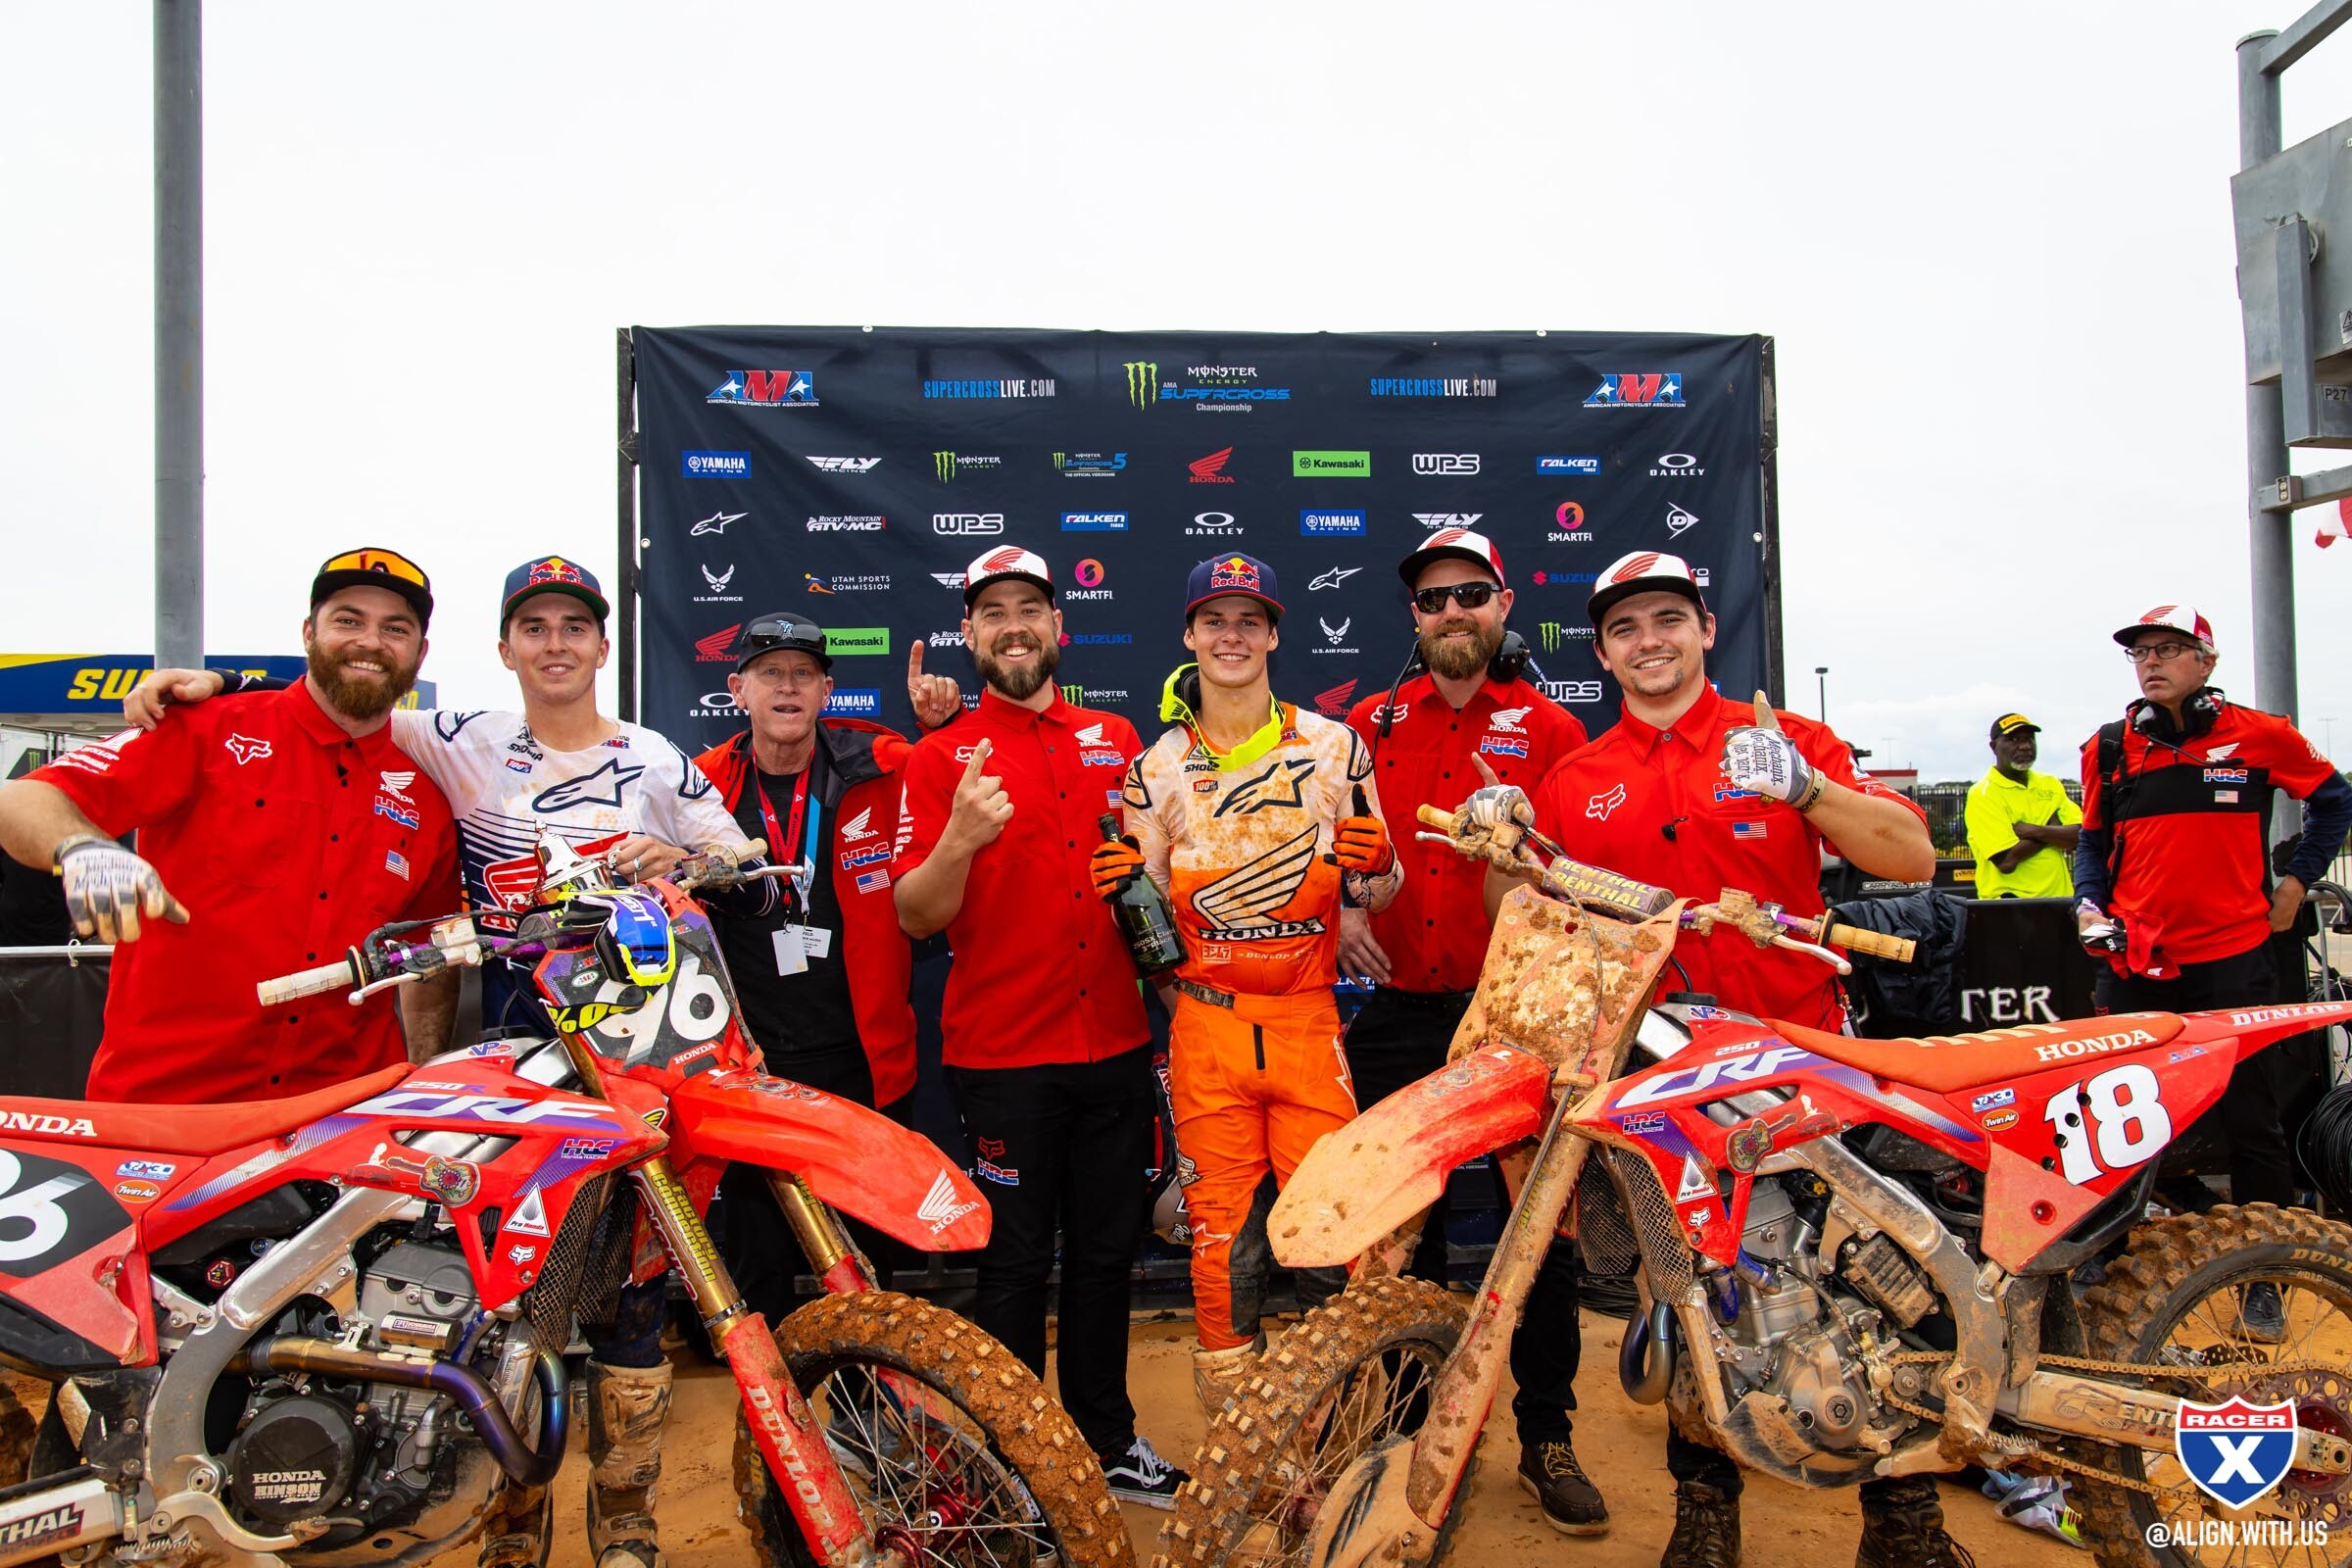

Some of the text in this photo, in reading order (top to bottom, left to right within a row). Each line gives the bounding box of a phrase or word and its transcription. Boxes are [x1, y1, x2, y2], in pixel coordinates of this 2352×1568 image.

[1188, 366, 1257, 377] MONSTER
[706, 369, 819, 401] AMA
[924, 379, 1055, 398] SUPERCROSSLIVE.COM
[1160, 389, 1291, 400] SUPERCROSS
[1370, 378, 1496, 397] SUPERCROSSLIVE.COM
[1582, 373, 1686, 403] AMA
[2325, 387, 2347, 401] P27
[1196, 403, 1251, 413] Championship
[702, 458, 745, 468] YAMAHA
[813, 456, 882, 468] FLY
[1314, 459, 1364, 468] Kawasaki
[1412, 454, 1480, 475] WPS
[933, 514, 1004, 535] WPS
[1318, 515, 1360, 527] YAMAHA
[1211, 575, 1260, 592] Red Bull
[1549, 573, 1596, 583] SUZUK
[830, 636, 883, 646] Kawasaki
[1074, 634, 1132, 644] SUZUKI
[831, 695, 874, 707] YAMAHA
[1489, 724, 1528, 735] HONDA
[1480, 736, 1529, 759] HRC
[507, 760, 532, 773] 100%
[1079, 750, 1124, 766] HRC
[1766, 736, 1787, 786] Mechanix
[2204, 769, 2248, 783] HRC
[379, 784, 416, 806] HONDA
[1194, 781, 1218, 792] 100%
[374, 796, 419, 830] HRC
[844, 830, 879, 843] HONDA
[841, 842, 891, 870] HRC
[1199, 918, 1325, 942] HONDA
[2230, 1004, 2343, 1026] DUNLOP
[673, 1041, 716, 1065] HONDA
[2034, 1029, 2158, 1062] HONDA
[1615, 1046, 1813, 1108] CRF
[343, 1093, 615, 1123] CRF
[0, 1111, 97, 1137] NDA
[1623, 1111, 1665, 1131] HRC
[1985, 1112, 2016, 1127] Twin Air
[2044, 1063, 2173, 1186] 18
[562, 1138, 613, 1156] HRC
[977, 1157, 1019, 1185] HRC
[118, 1185, 157, 1198] Twin Air
[928, 1200, 981, 1235] HONDA
[2289, 1249, 2352, 1274] DUNL
[745, 1385, 833, 1529] DUNLOP
[252, 1470, 326, 1483] HONDA
[255, 1483, 321, 1496] HINSON
[0, 1507, 78, 1546] THAL
